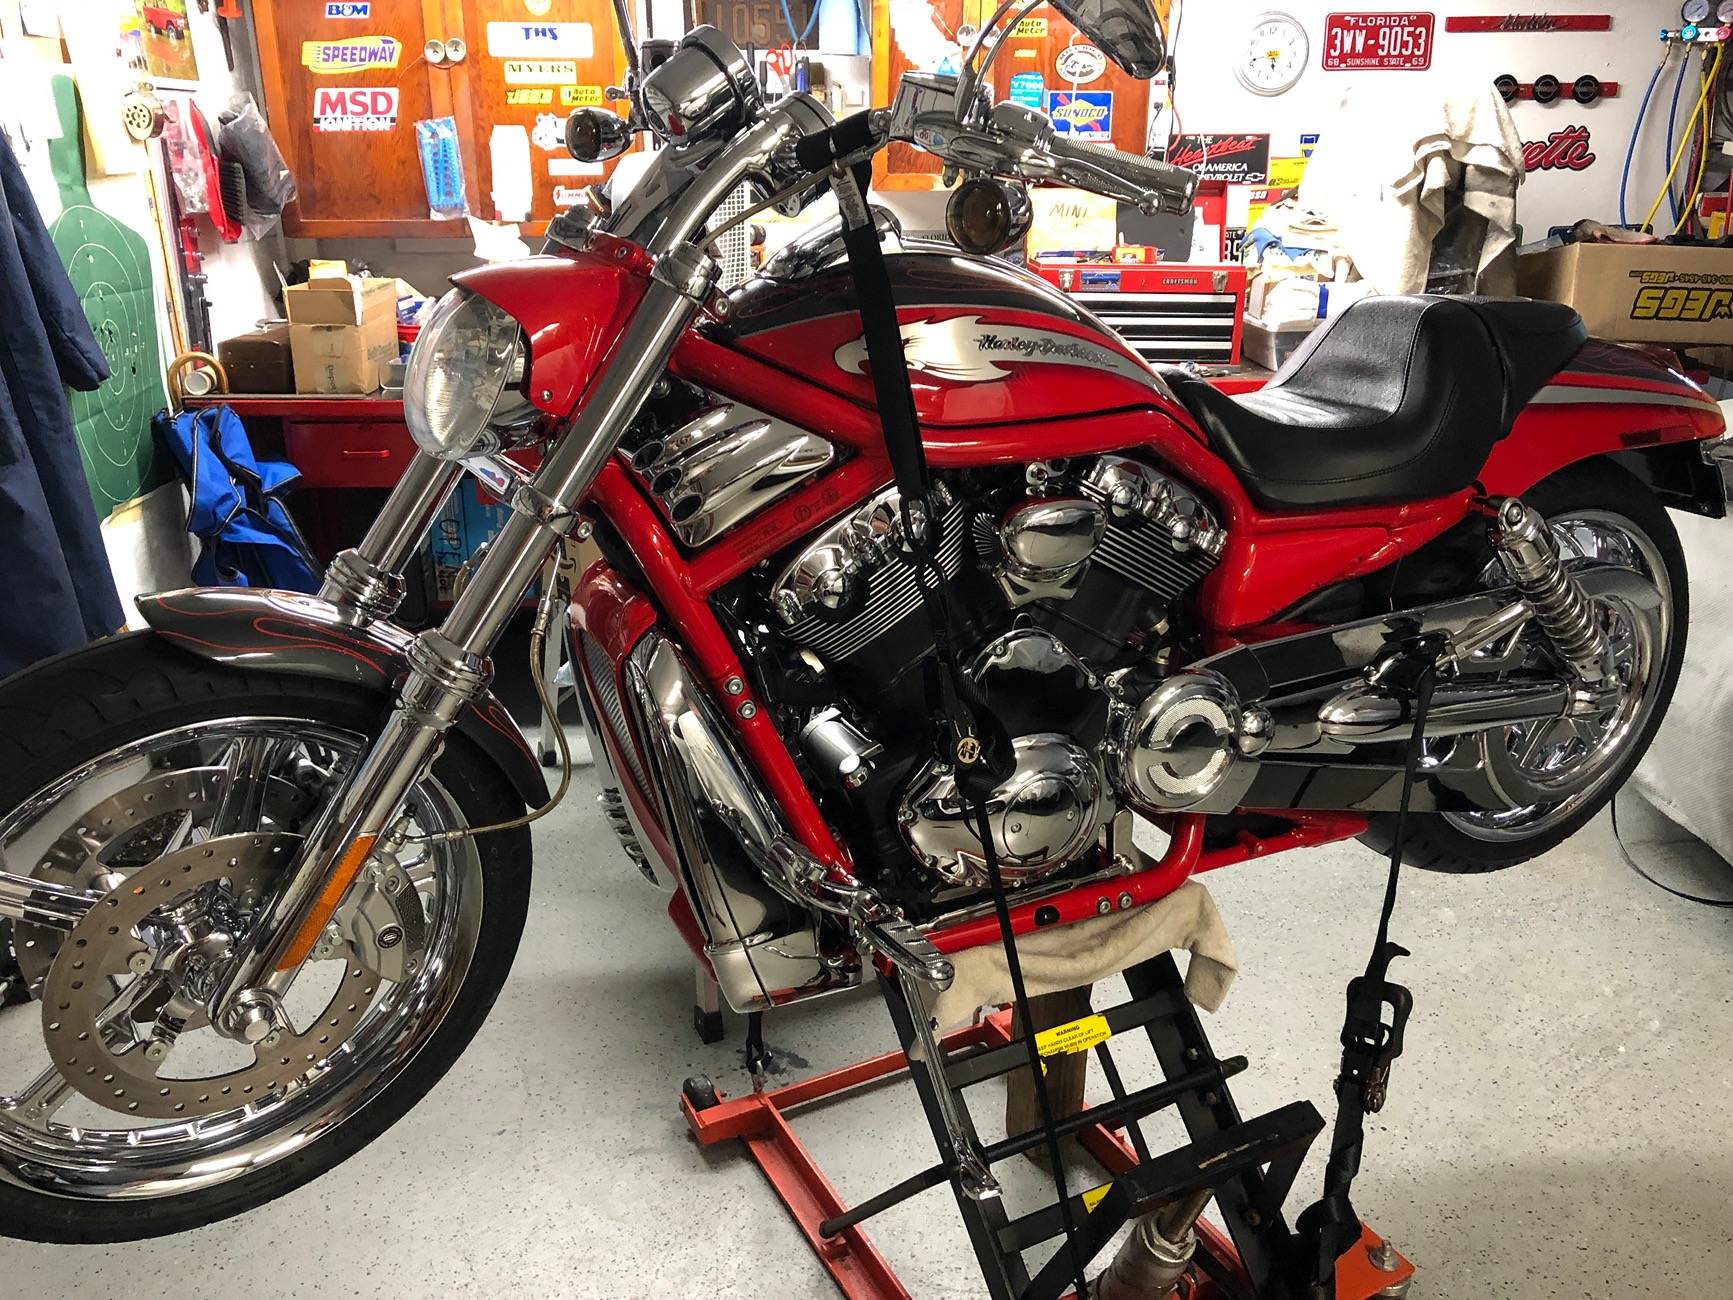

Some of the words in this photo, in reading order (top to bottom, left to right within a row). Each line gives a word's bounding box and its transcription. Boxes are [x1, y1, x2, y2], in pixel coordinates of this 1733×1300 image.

[327, 4, 369, 16] B&M
[1350, 16, 1409, 26] FLORIDA
[1016, 27, 1046, 35] Meter
[1330, 26, 1426, 56] 3WW-9053
[322, 46, 395, 62] SPEEDWAY
[1328, 58, 1340, 66] 68
[1384, 57, 1404, 65] STATE
[1412, 57, 1425, 65] 69
[508, 64, 574, 73] MYERS
[320, 91, 393, 116] MSD
[571, 95, 600, 103] Meter
[1055, 108, 1105, 118] SUNOCO
[1197, 135, 1214, 144] THE
[1204, 162, 1248, 172] AMERICA
[1630, 287, 1733, 322] JEGS
[1056, 1025, 1080, 1036] WARNING
[1063, 1034, 1079, 1043] CLEAR
[1085, 1028, 1094, 1036] LIFT
